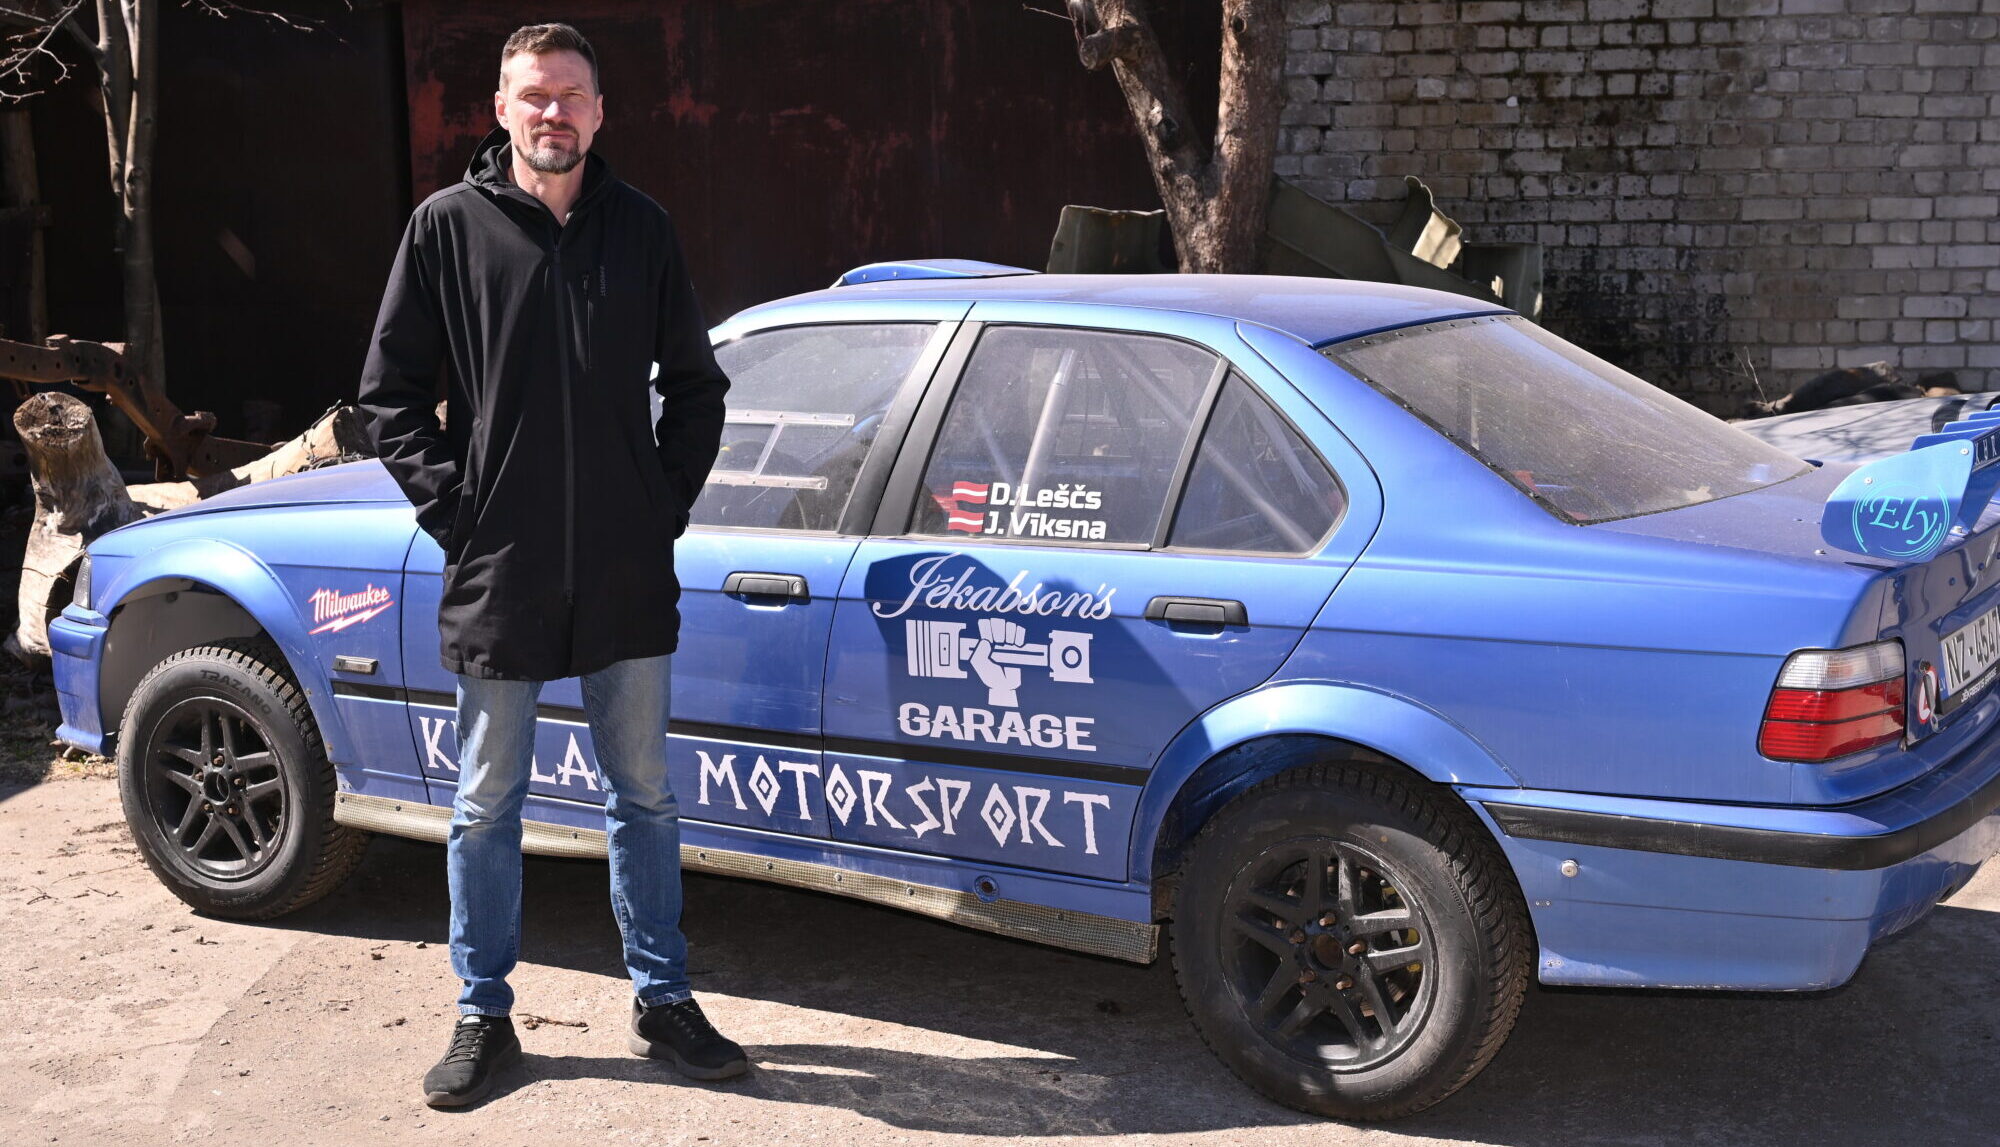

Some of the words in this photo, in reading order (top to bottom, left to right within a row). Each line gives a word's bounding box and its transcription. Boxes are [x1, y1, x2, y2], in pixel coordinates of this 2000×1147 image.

[984, 511, 1005, 535] J.
[1010, 512, 1107, 540] Vīksna
[1869, 496, 1938, 545] Ely
[307, 582, 391, 624] Milwaukee
[201, 670, 273, 715] TRAZANO
[897, 702, 1097, 752] GARAGE
[697, 750, 1111, 855] MOTORSPORT
